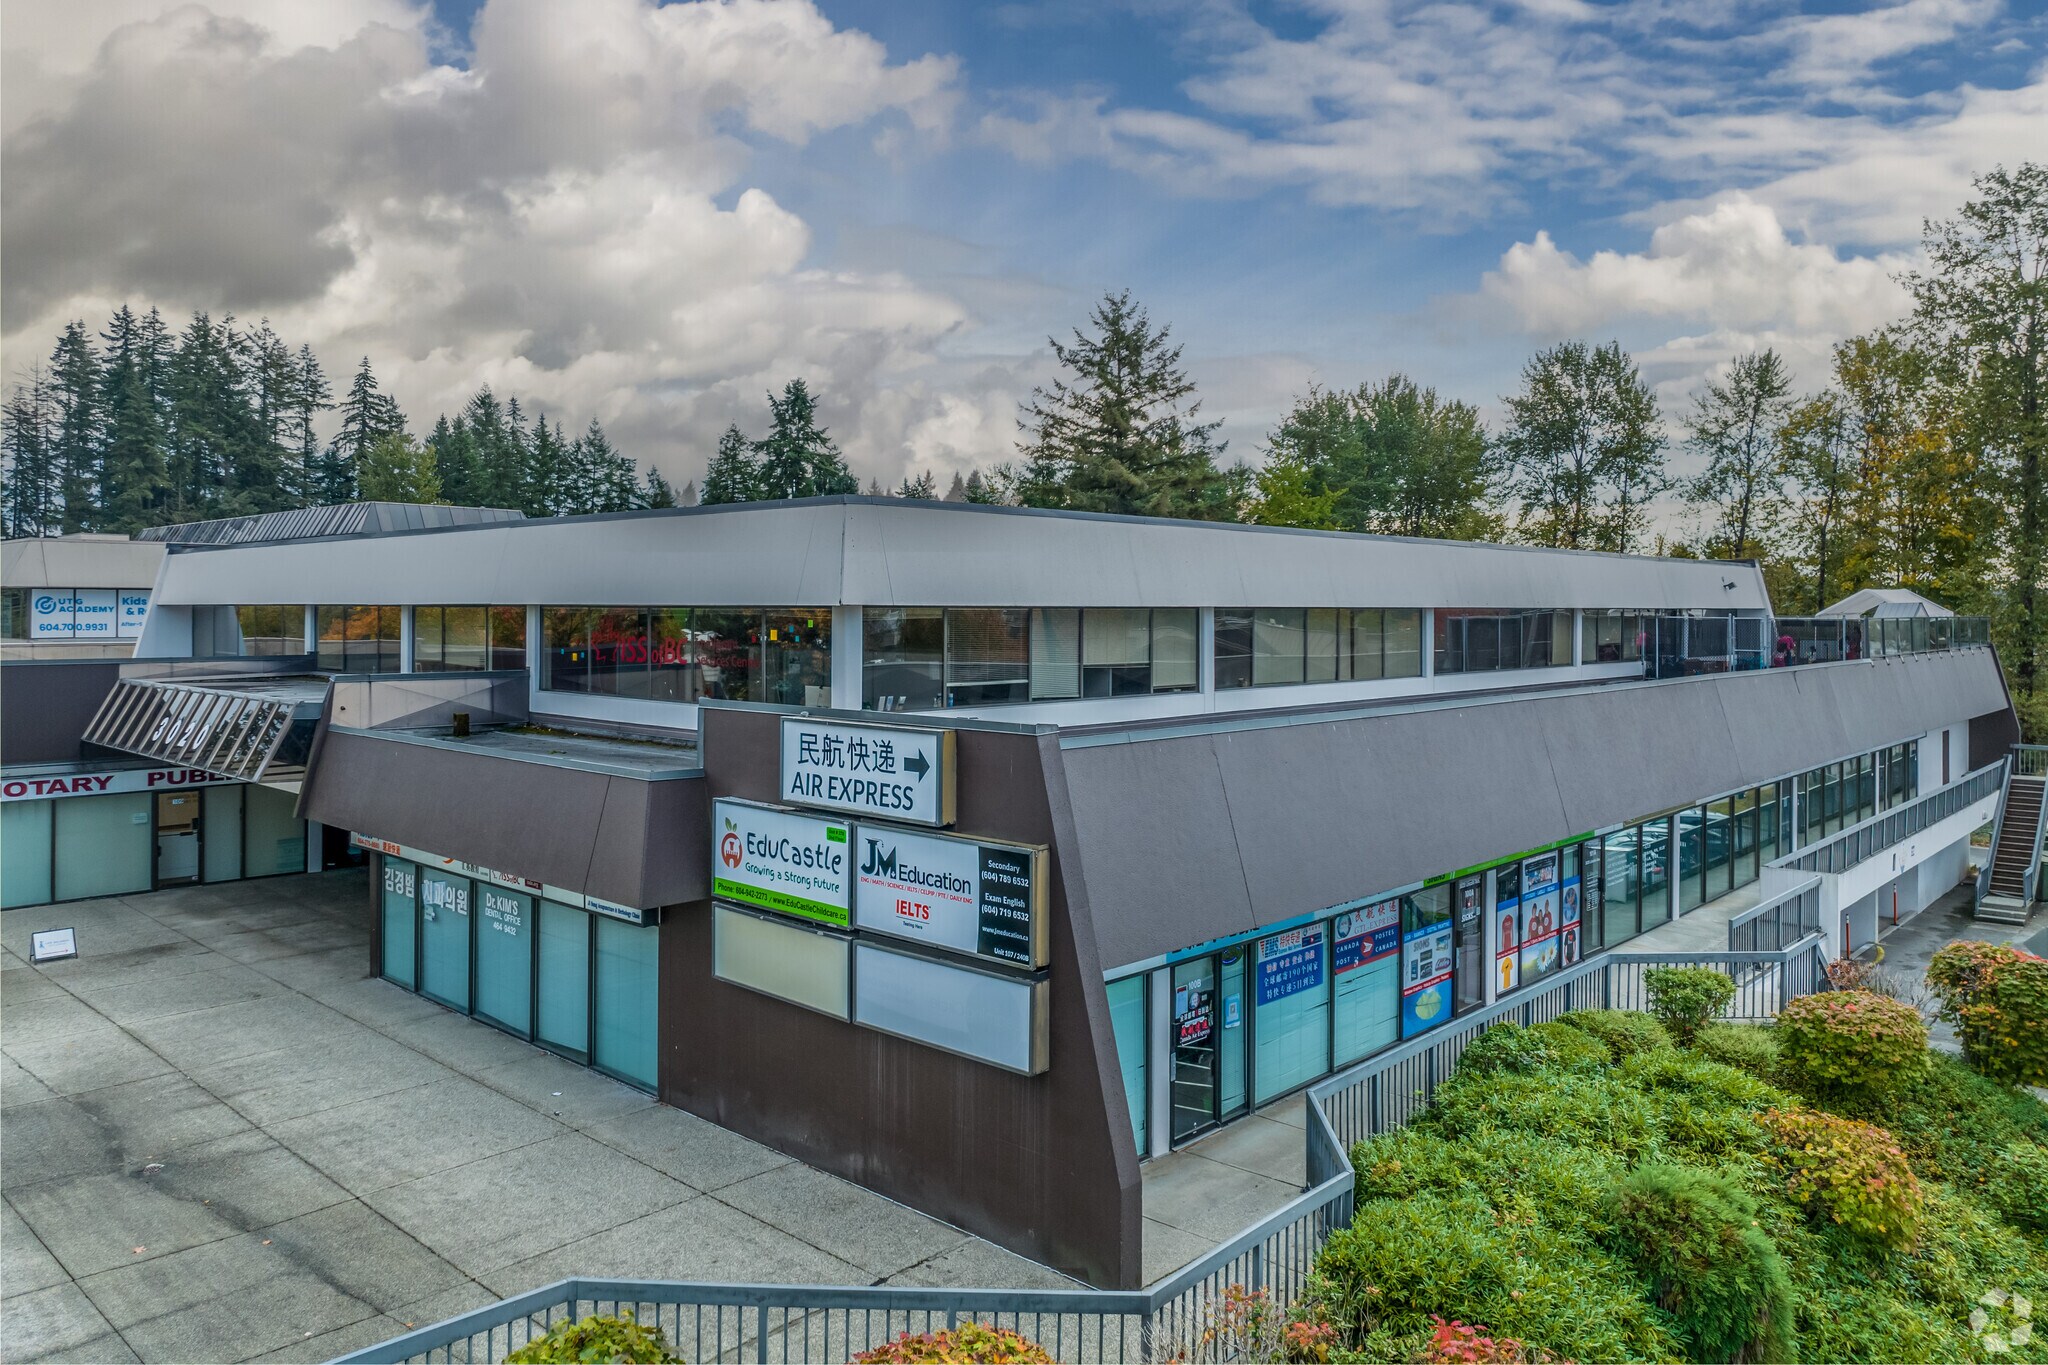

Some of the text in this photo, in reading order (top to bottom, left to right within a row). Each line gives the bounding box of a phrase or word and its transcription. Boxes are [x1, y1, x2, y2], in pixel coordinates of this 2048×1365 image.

[122, 597, 147, 605] Kids
[138, 607, 147, 616] R
[39, 623, 108, 631] 604.700.9931
[152, 717, 210, 749] 3020
[797, 732, 897, 775] 民航快递
[0, 769, 233, 797] OTARY PUBL
[790, 772, 914, 811] AIR EXPRESS
[747, 832, 842, 875] EduCastle
[861, 838, 971, 895] JM Education
[988, 860, 1020, 874] Secondary
[384, 867, 414, 898] 김경범
[745, 862, 840, 893] Growing a Strong Future
[981, 871, 1029, 887] (604) 789 6532
[872, 879, 884, 887] MATH
[887, 882, 904, 890] SCIENCE
[920, 889, 935, 897] CELPIP
[950, 894, 962, 902] DAILY
[486, 892, 519, 916] Dr. KIM'S
[718, 882, 735, 893] Phone:
[772, 897, 846, 920] www.EduCastleChildcare.ca
[985, 892, 1026, 908] Exam English
[485, 907, 521, 926] DENTAL OFFICE
[895, 899, 929, 920] IELTS
[981, 904, 1029, 922] (604) 719 6532
[493, 921, 517, 936] 464 9432
[982, 926, 1029, 941] www.jmeducation.ca
[1375, 929, 1395, 940] POSTES
[1336, 941, 1359, 953] CANADA
[1375, 941, 1397, 952] CANADA
[1336, 957, 1350, 966] POST
